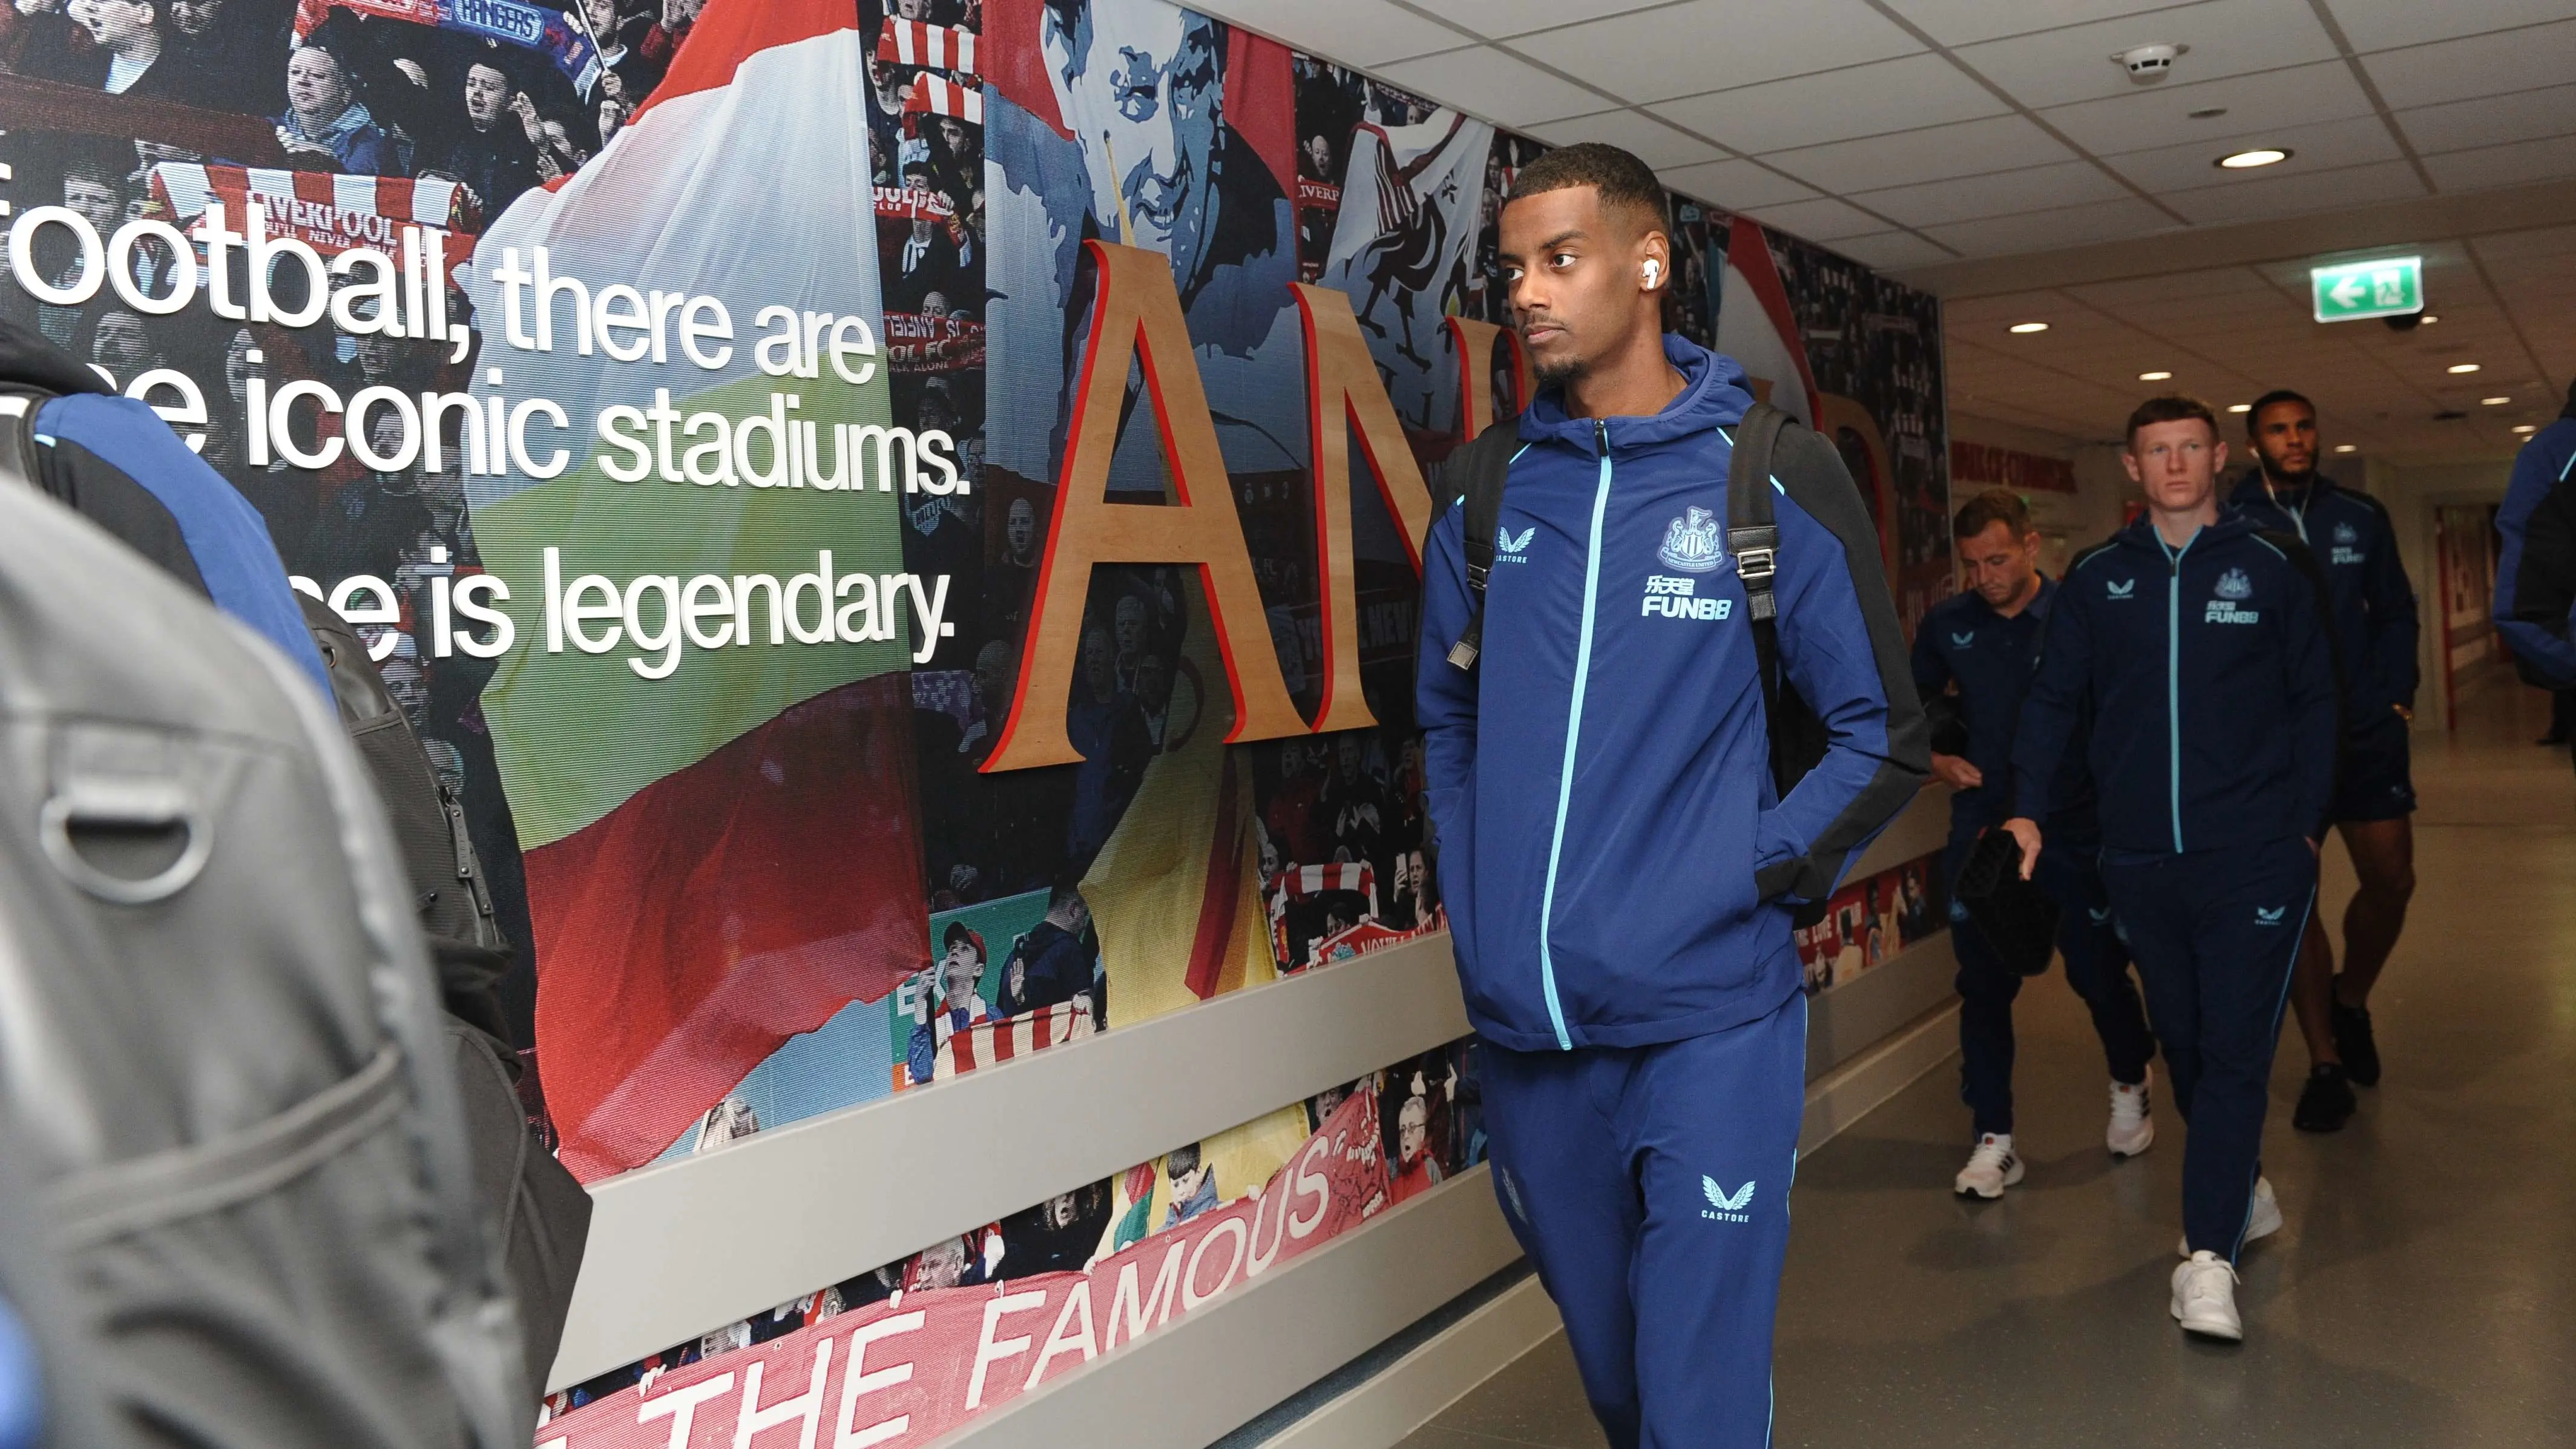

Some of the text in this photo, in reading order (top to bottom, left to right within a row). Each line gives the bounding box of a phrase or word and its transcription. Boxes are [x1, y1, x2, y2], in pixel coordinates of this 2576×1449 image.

[0, 161, 876, 385] ootball, there are
[85, 349, 970, 495] e iconic stadiums.
[431, 547, 516, 658] is
[544, 547, 954, 680] legendary.
[1641, 596, 1732, 620] FUN88
[1644, 575, 1695, 596] 乐天堂
[1701, 1209, 1749, 1223] CASTORE
[638, 1136, 1330, 1449] THE FAMOUS
